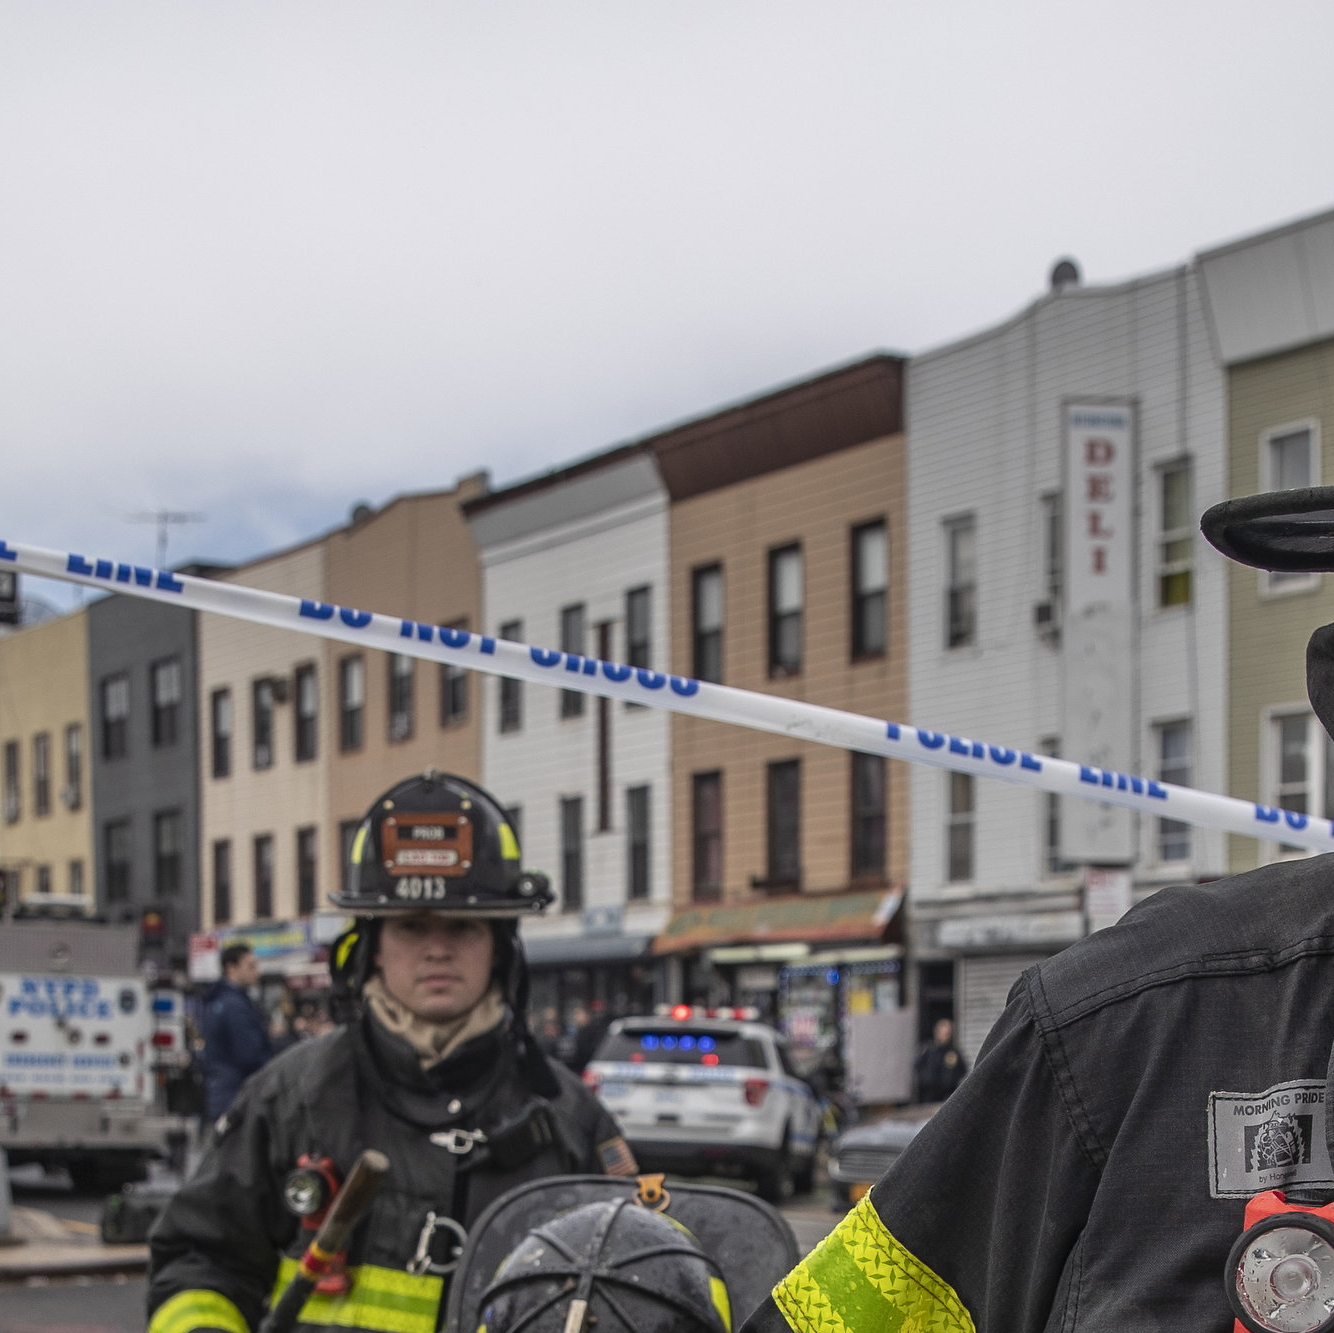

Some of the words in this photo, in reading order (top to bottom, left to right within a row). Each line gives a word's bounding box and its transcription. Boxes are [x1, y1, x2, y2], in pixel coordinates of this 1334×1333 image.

[1084, 438, 1115, 575] DELI
[395, 876, 446, 899] 4013
[1233, 1094, 1290, 1117] MORNING
[1294, 1092, 1325, 1105] PRIDE
[1259, 1175, 1269, 1184] by
